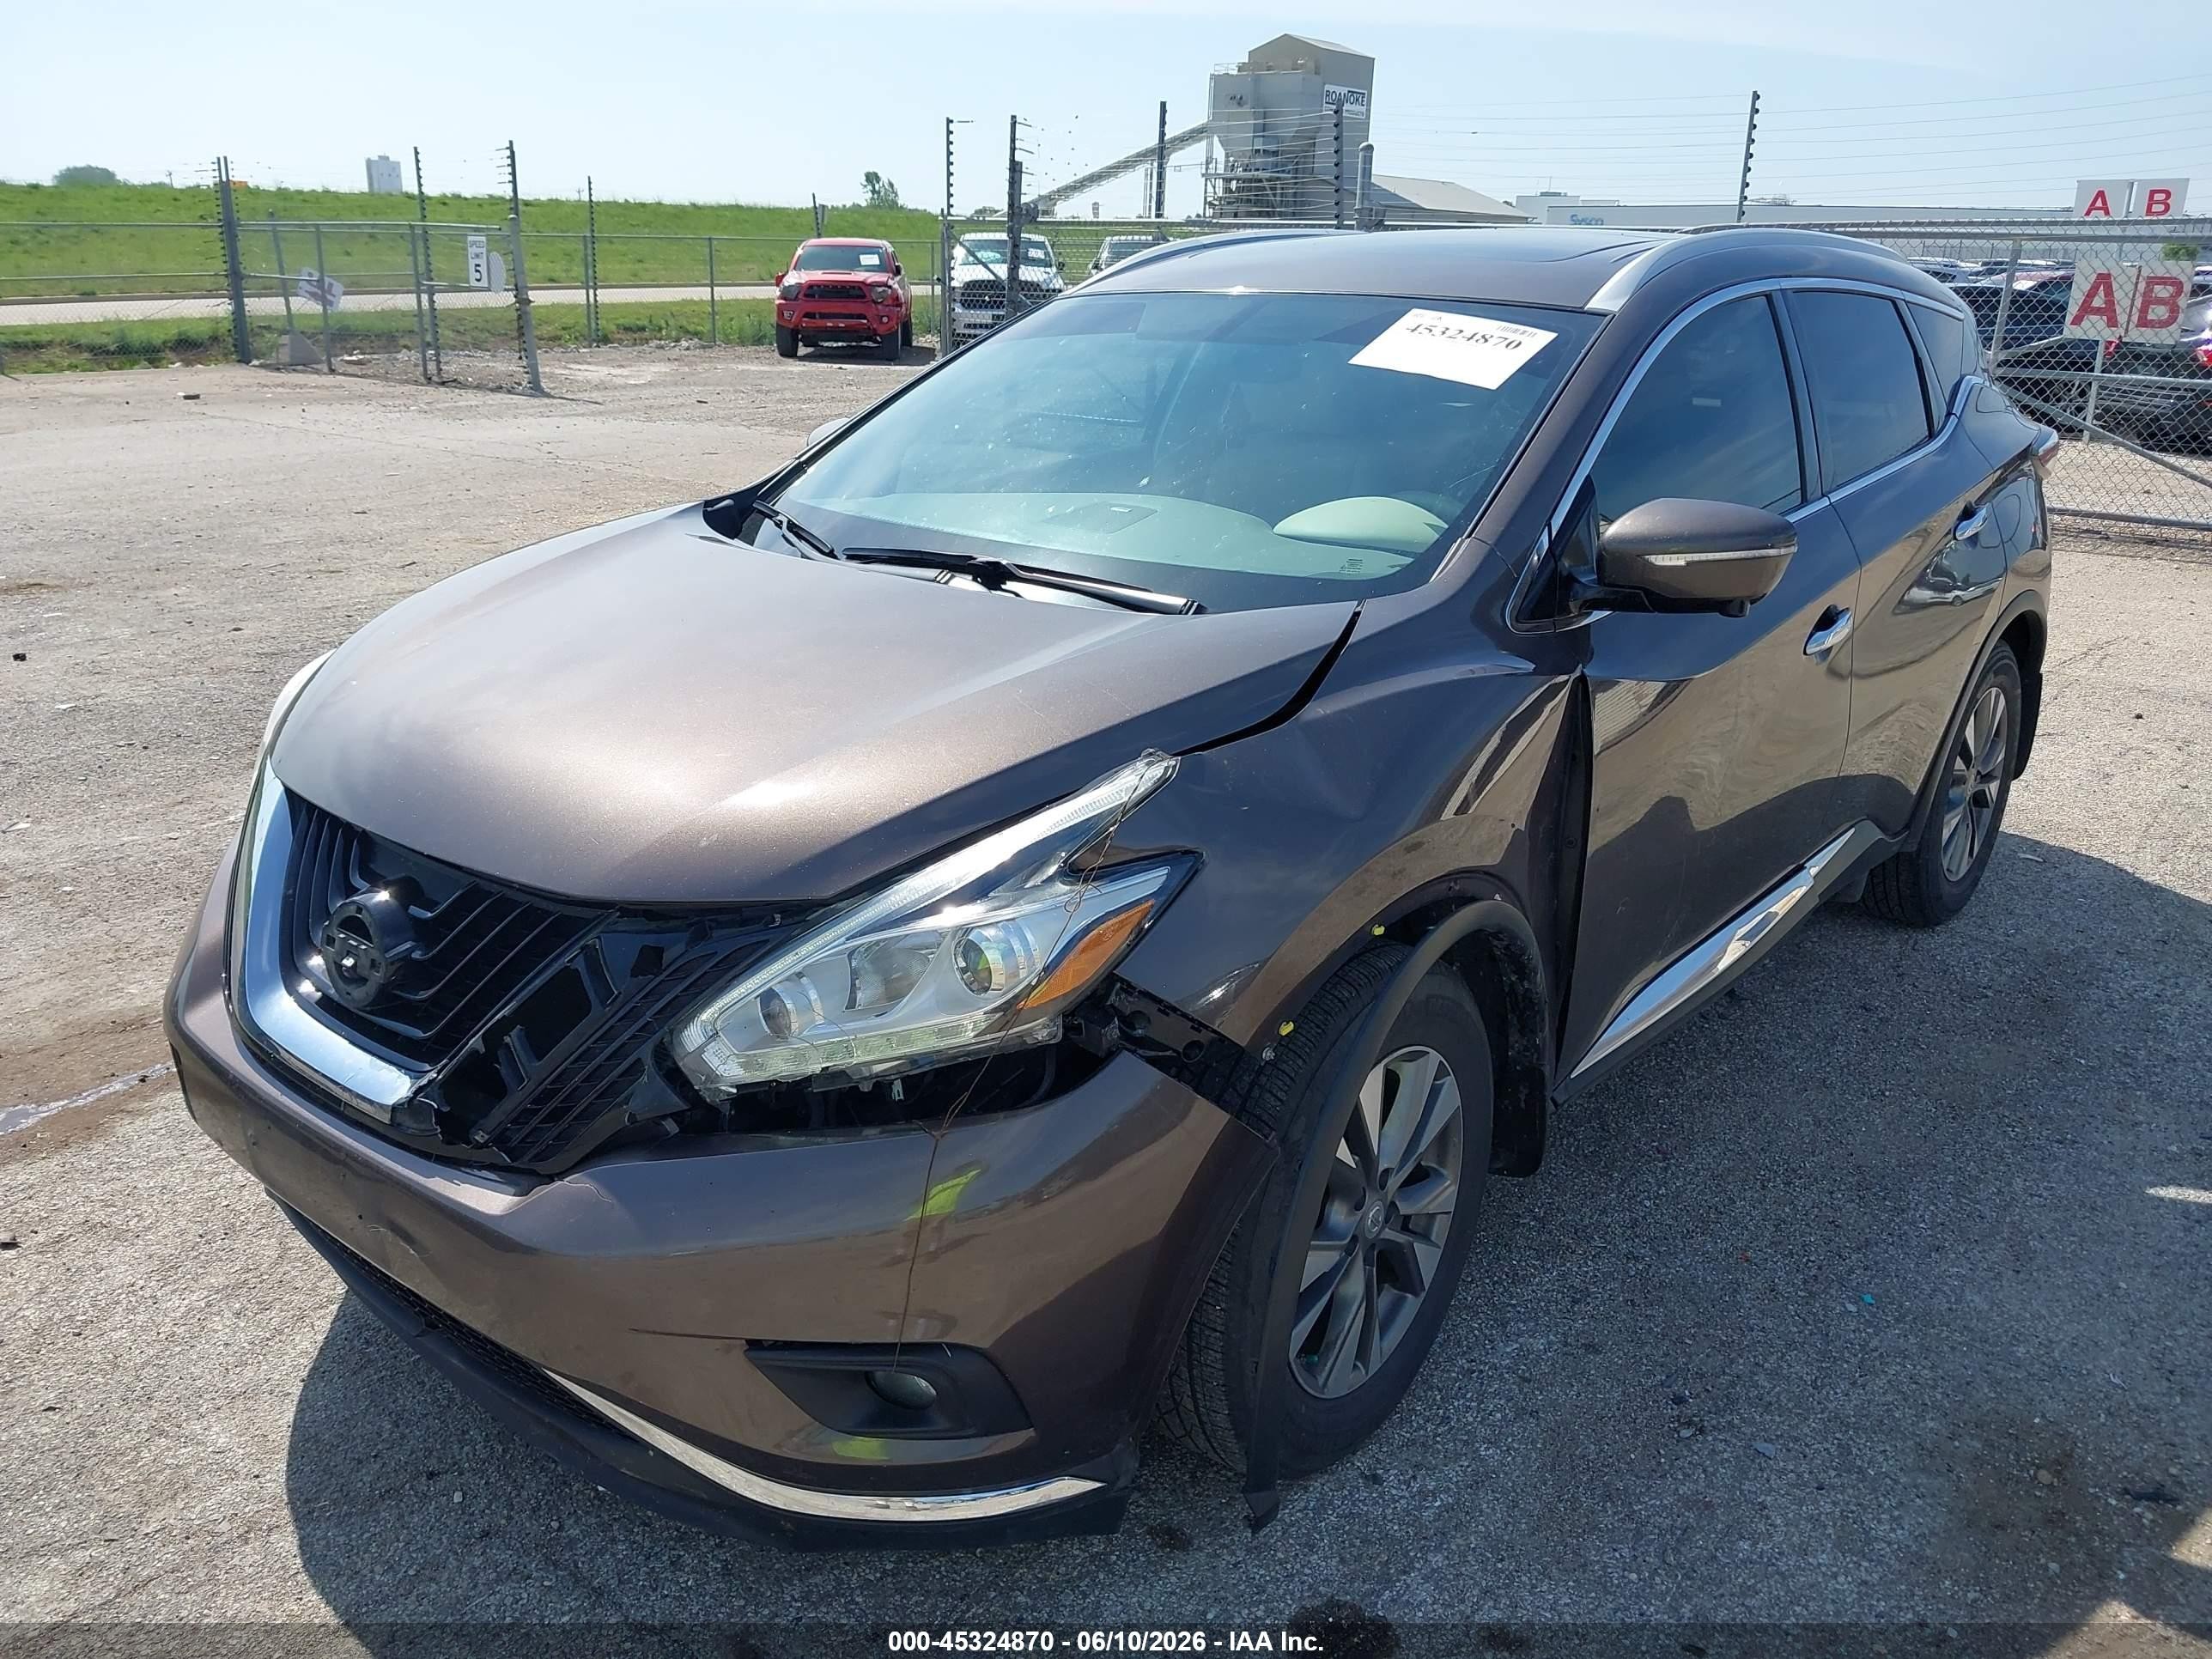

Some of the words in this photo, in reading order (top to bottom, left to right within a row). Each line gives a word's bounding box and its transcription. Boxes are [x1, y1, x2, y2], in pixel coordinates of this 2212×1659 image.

[1324, 89, 1366, 106] ROANOKE
[2084, 190, 2111, 216] A
[2145, 189, 2172, 216] B
[474, 264, 483, 283] 5
[2069, 272, 2119, 328] A
[2135, 276, 2185, 329] B
[1406, 324, 1522, 350] 45324870
